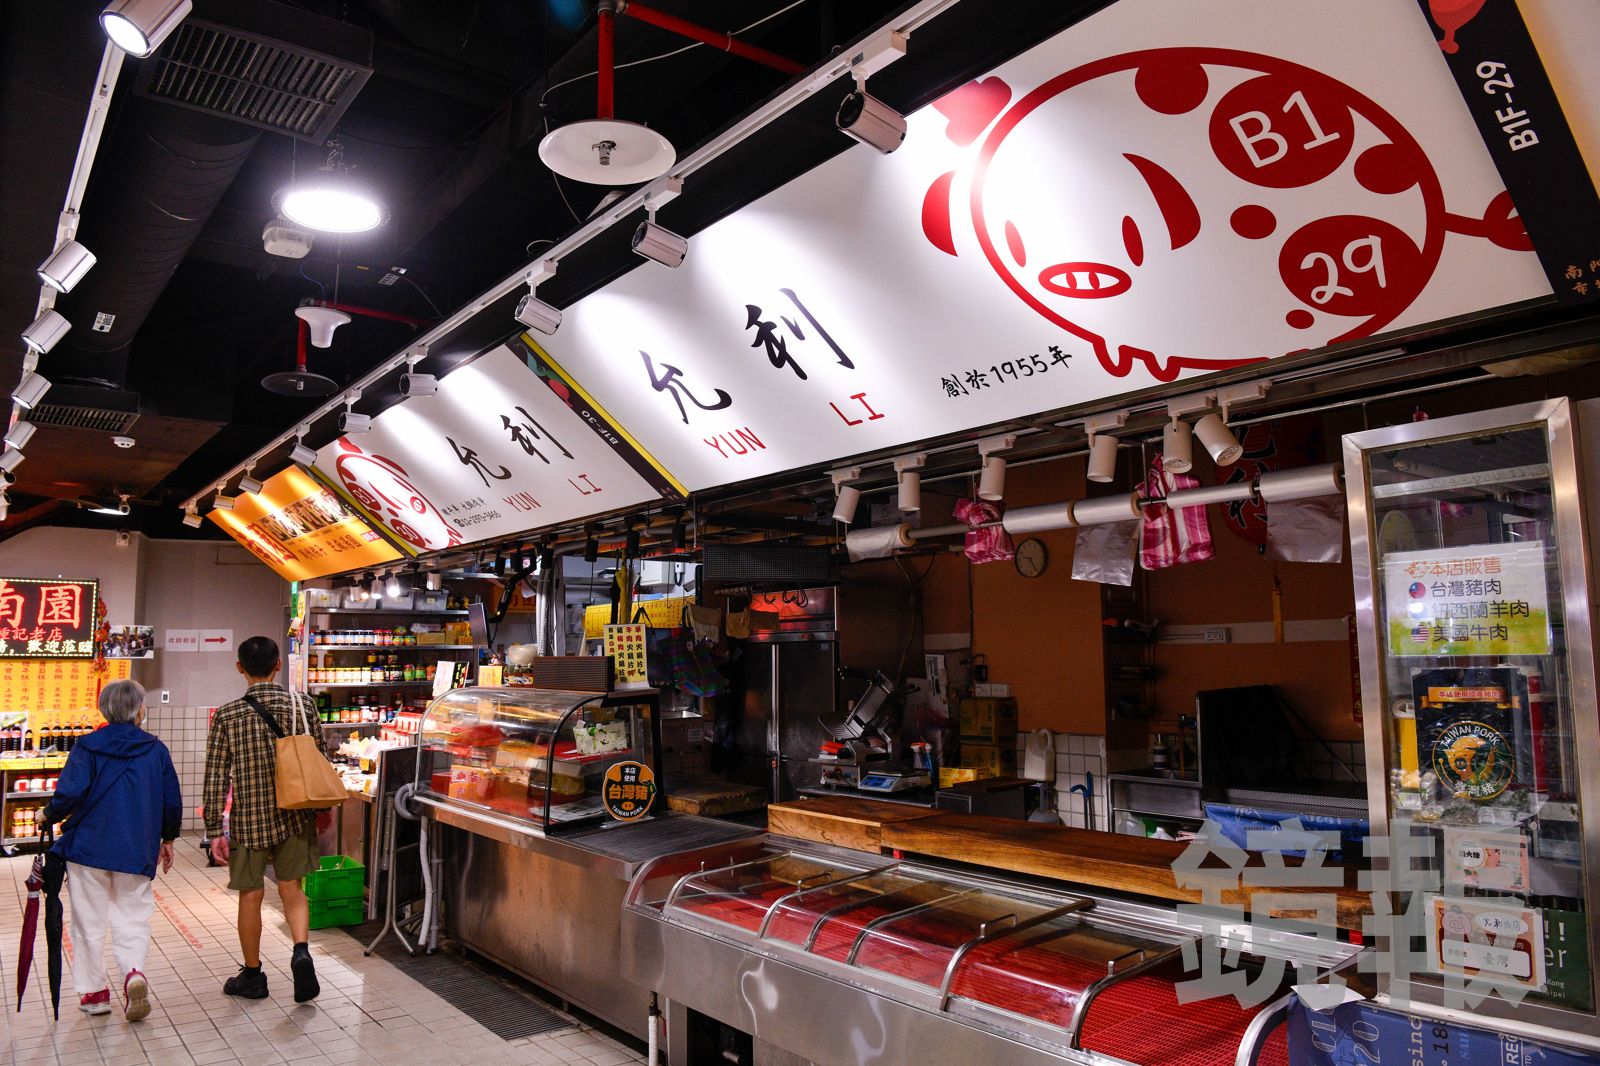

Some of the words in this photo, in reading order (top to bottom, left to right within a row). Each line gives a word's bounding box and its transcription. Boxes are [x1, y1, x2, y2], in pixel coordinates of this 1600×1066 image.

[1475, 60, 1540, 152] B1F-29
[1229, 89, 1340, 169] B1
[1299, 234, 1386, 304] 29
[940, 345, 1073, 398] 創於1955年
[581, 409, 619, 446] B1F-30
[702, 426, 767, 459] YUN
[829, 392, 885, 427] LI
[350, 487, 377, 511] B1
[502, 491, 542, 512] YUN
[567, 473, 602, 496] LI
[396, 522, 421, 542] 30
[1429, 557, 1502, 577] 本店販售
[1430, 578, 1502, 598] 台灣豬肉
[1432, 599, 1530, 620] 紐西蘭羊肉
[1433, 624, 1509, 642] 美國牛肉
[1440, 725, 1472, 747] TAIWAN
[1473, 725, 1500, 746] PORK
[609, 784, 648, 800] 台灣豬
[611, 804, 630, 817] TAIWAN
[630, 805, 644, 817] PORK
